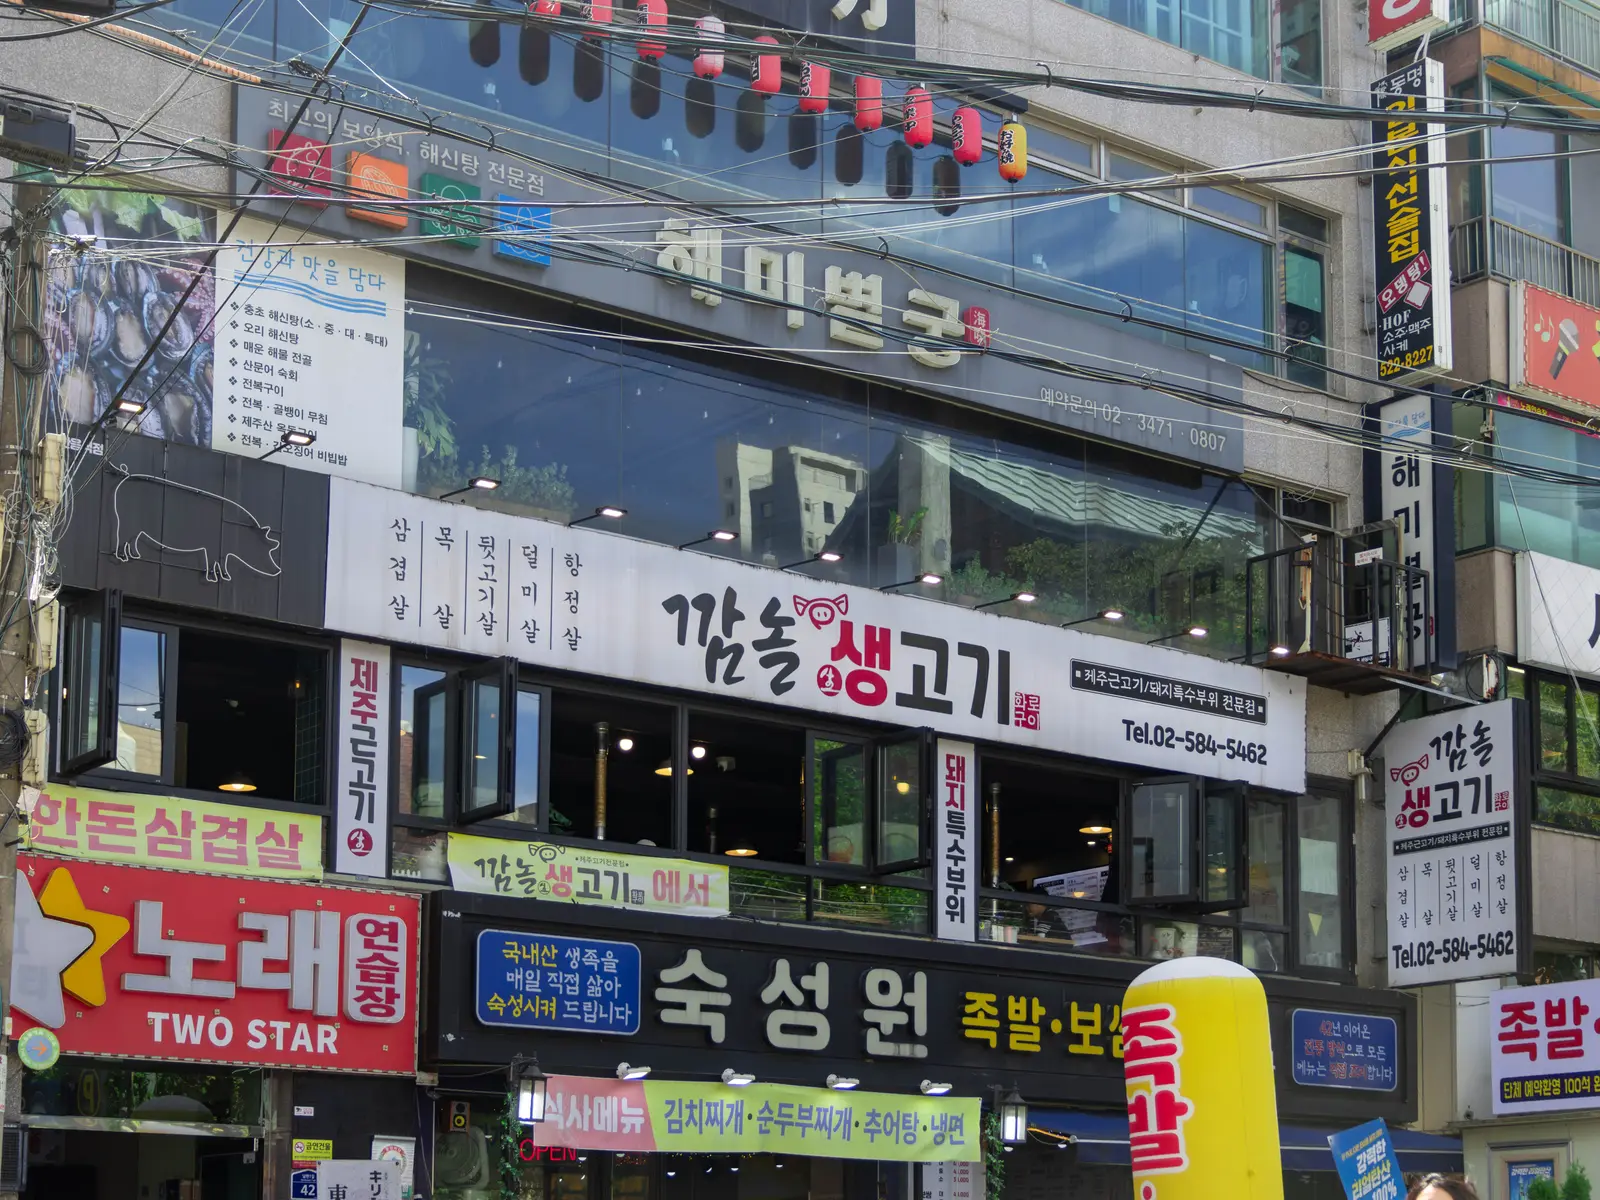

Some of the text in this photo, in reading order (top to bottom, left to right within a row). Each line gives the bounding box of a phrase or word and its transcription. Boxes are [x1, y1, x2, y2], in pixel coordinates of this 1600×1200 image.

[1390, 65, 1422, 95] 동명
[268, 98, 333, 134] 최고의
[419, 141, 479, 176] 해신탕
[488, 160, 545, 197] 전문점
[303, 256, 340, 286] 맛을
[349, 266, 386, 293] 담다
[1382, 256, 1428, 309] 오뎅탕!
[243, 322, 300, 346] 오리 해신탕
[243, 340, 313, 367] 매운 해물 전골
[242, 378, 284, 397] 전복구이
[243, 359, 298, 382] 산문어 숙회
[241, 415, 273, 432] 제주산
[242, 397, 328, 425] 전복 골뱅이 무침
[1040, 387, 1227, 453] 예약문의 02 3471 0807
[241, 434, 262, 448] 전복
[317, 450, 348, 467] 비빔밥
[388, 517, 411, 621] 삼겹살
[476, 535, 498, 637] 뒷고기살
[519, 544, 541, 644] 덜미살
[563, 552, 583, 652] 항정살
[661, 585, 1011, 726] 깜놀 생고기
[1222, 695, 1256, 716] 전문점
[349, 657, 379, 824] 제주근고기
[1121, 718, 1268, 766] Tel.02-584-5462
[1428, 720, 1494, 773] 깜놀
[1401, 774, 1493, 829] 생고기
[32, 793, 304, 871] 한돈삼겹살
[945, 753, 967, 924] 돼지특수부위
[474, 854, 710, 907] 깜놀 생고기 에서
[1397, 866, 1409, 929] 삼겹살
[1445, 858, 1458, 922] 뒷고기살
[1470, 854, 1483, 919] 덜미살
[1495, 850, 1508, 915] 항정살
[120, 899, 342, 1017] 노래
[354, 918, 401, 1018] 연습장
[502, 941, 619, 973] 국내산 생족을
[1392, 930, 1514, 969] Tel.02-584-5462
[506, 967, 622, 999] 매일 직접 삶아
[486, 992, 633, 1026] 숙성시켜 드립니다
[1319, 1020, 1371, 1039] 42년 이어온
[146, 1011, 339, 1055] TWO STAR
[1304, 1039, 1386, 1061] 전통 방식으로 모든
[1296, 1060, 1327, 1077] 메뉴는
[1503, 1079, 1522, 1099] 단체
[1524, 1078, 1561, 1098] 예약환영
[1563, 1076, 1591, 1094] 100석
[545, 1092, 646, 1135] 식사메뉴
[519, 1138, 577, 1161] OPEN
[1356, 1138, 1387, 1175] 강력한
[300, 1184, 316, 1196] 42
[370, 1171, 382, 1200] キリ
